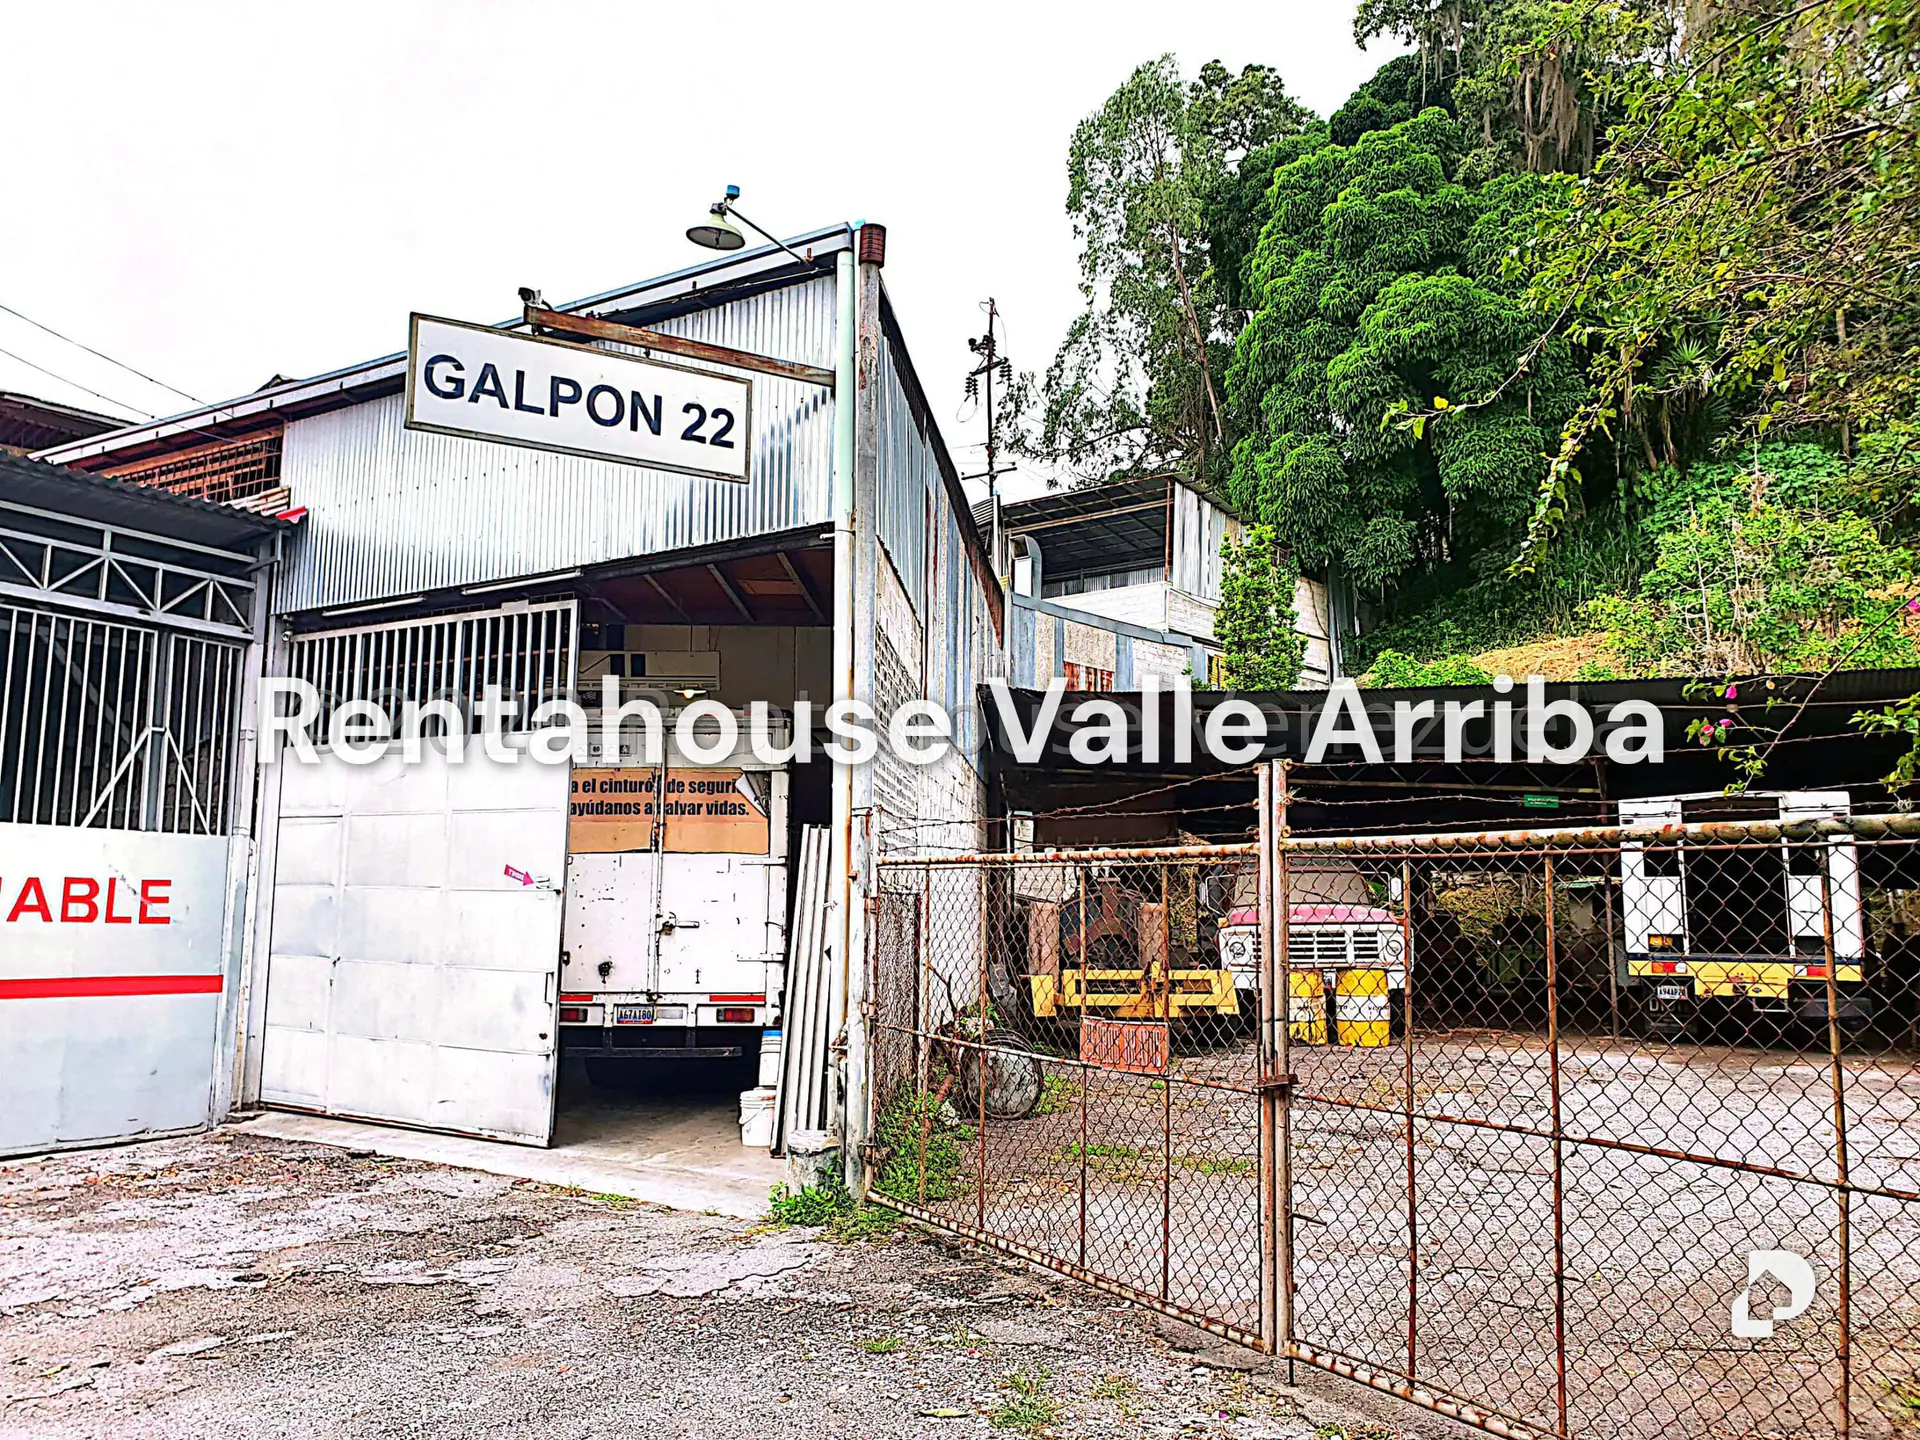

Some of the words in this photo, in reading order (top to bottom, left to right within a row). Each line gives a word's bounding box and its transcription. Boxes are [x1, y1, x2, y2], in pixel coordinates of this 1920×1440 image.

[424, 353, 663, 436] GALPON
[681, 402, 735, 449] 22
[582, 778, 597, 794] el
[599, 777, 657, 794] cinturó
[667, 778, 685, 794] de
[688, 779, 741, 796] seguri
[706, 800, 749, 816] vidas.
[0, 875, 173, 925] ABLE
